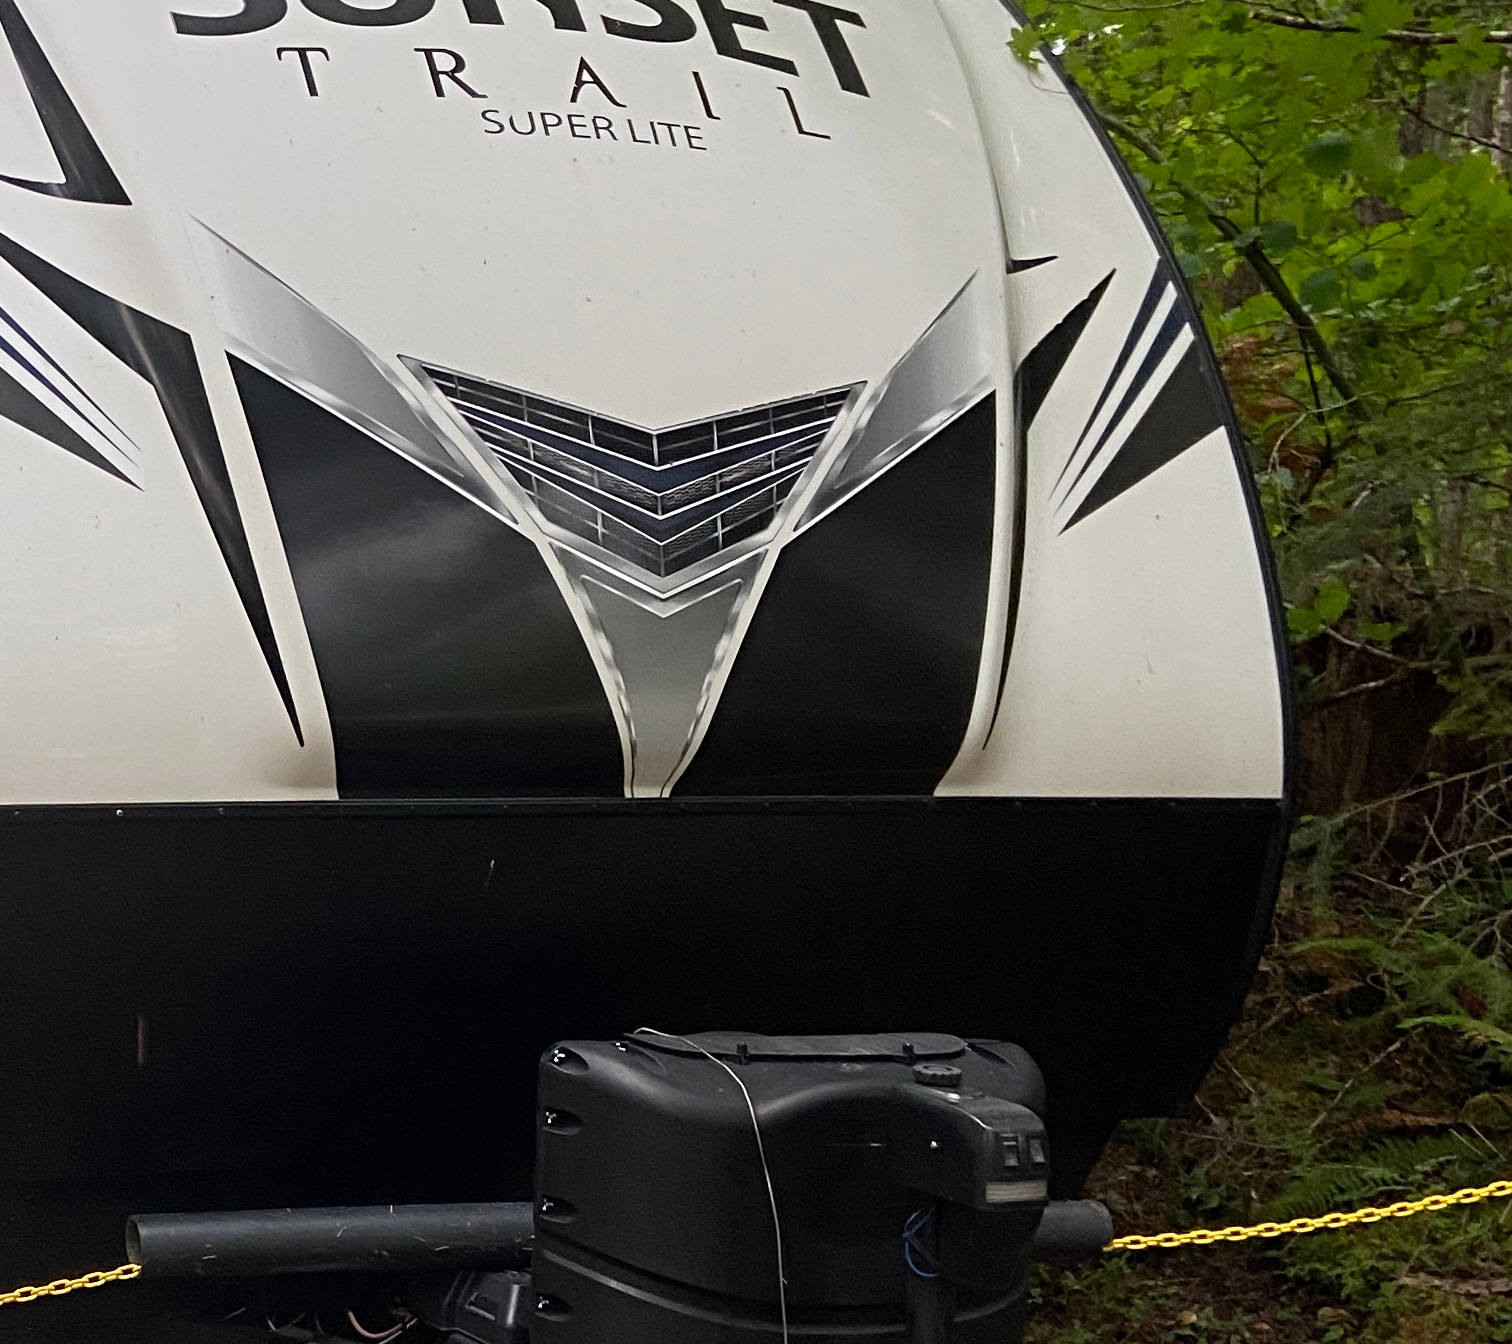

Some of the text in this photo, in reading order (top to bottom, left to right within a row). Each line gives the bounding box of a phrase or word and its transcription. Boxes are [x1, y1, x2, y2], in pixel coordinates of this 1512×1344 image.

[276, 47, 832, 141] TRAIL
[480, 109, 708, 151] SUPER LITE
